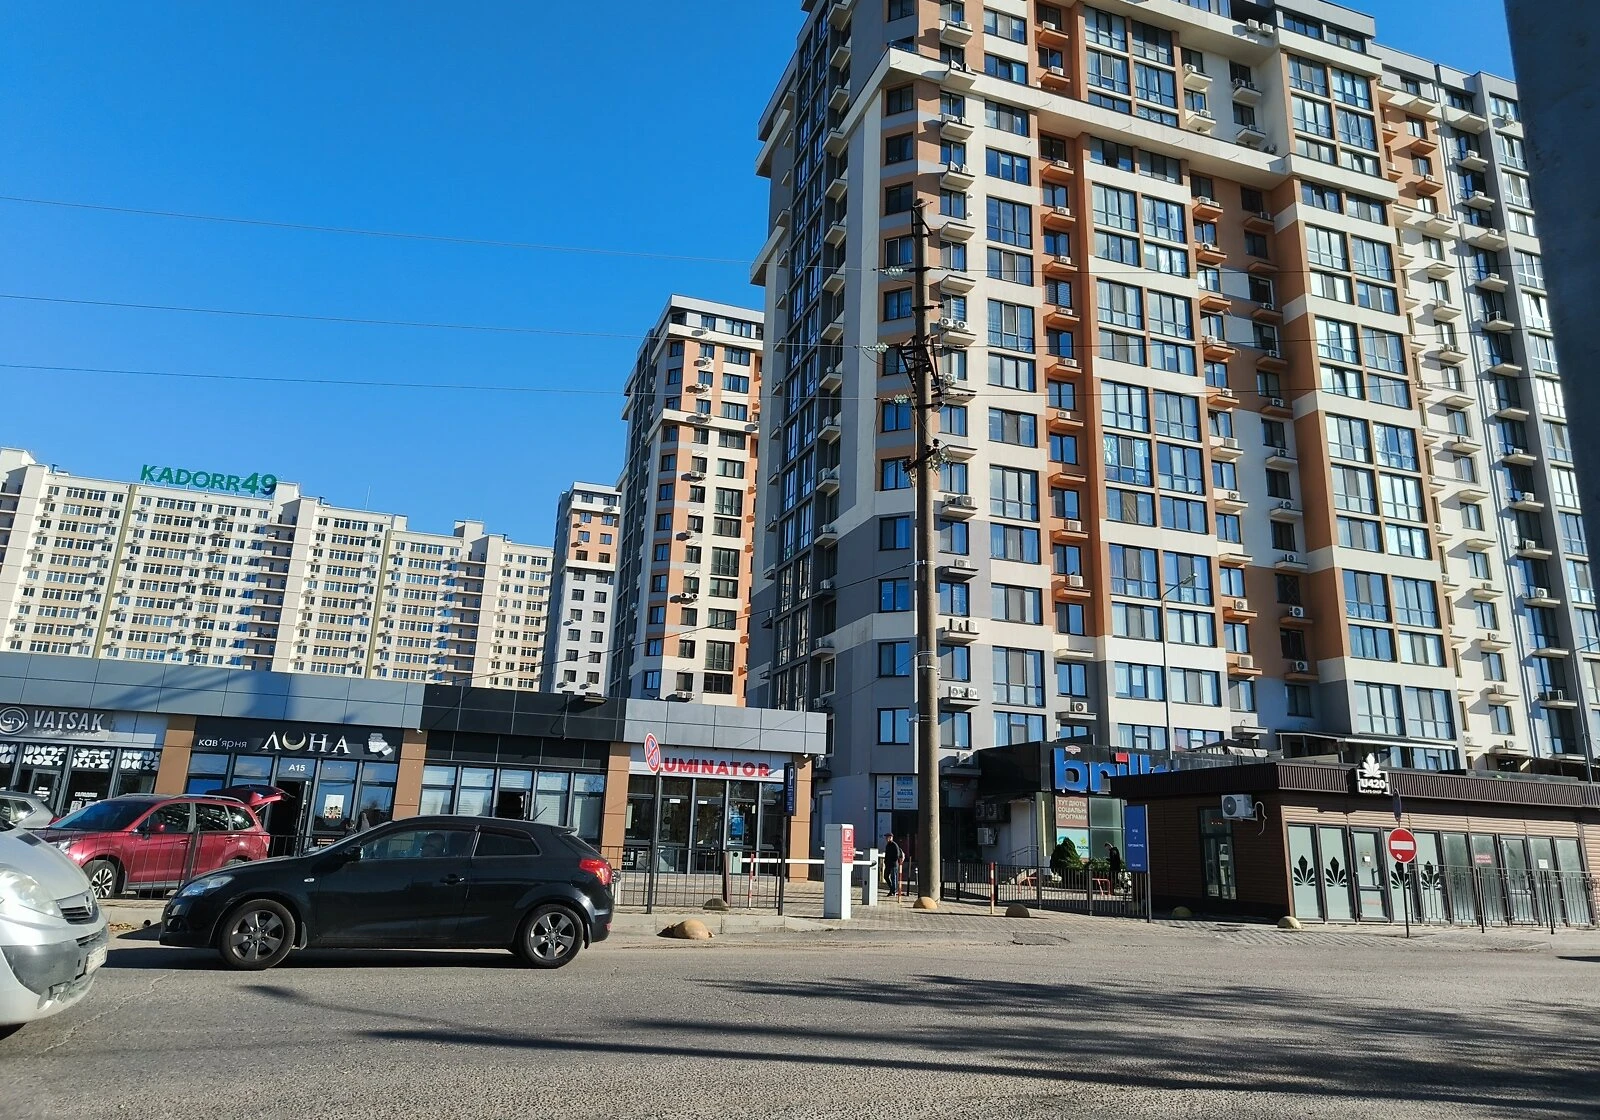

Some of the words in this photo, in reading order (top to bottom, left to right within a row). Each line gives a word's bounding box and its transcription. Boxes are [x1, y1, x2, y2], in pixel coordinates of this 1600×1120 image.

[34, 710, 104, 732] VATSAK
[288, 763, 305, 772] A15
[660, 757, 770, 777] UMINATOR
[1360, 778, 1386, 789] U420
[1057, 806, 1087, 814] СОЦІАЛЬНІ
